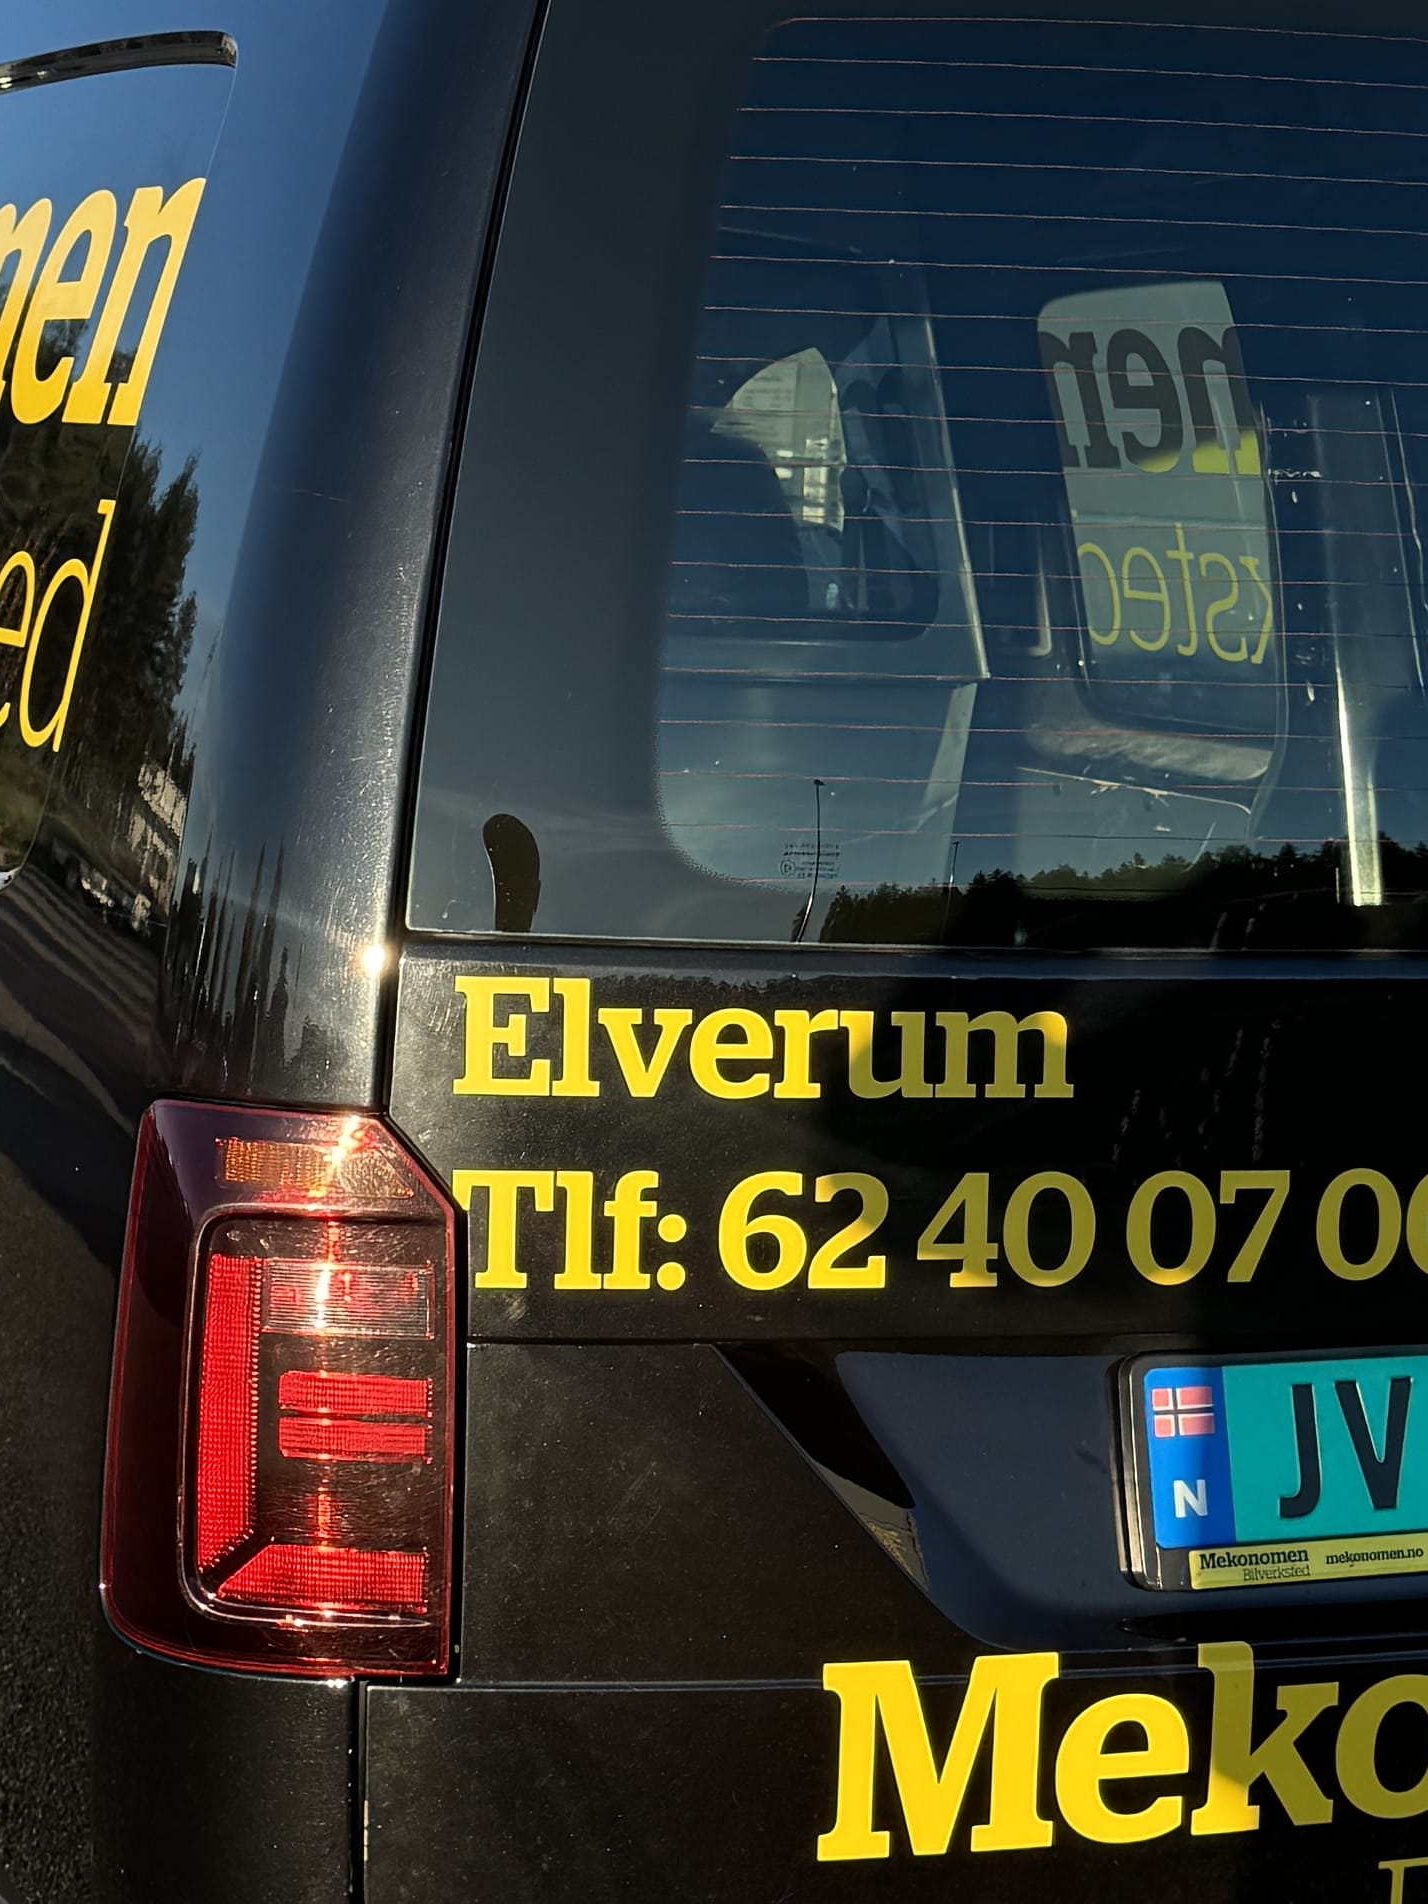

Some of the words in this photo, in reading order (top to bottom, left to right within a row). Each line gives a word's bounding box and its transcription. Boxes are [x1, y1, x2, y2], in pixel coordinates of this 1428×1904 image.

[451, 976, 1075, 1100] Elverum
[449, 1169, 688, 1292] Tlf:
[718, 1169, 888, 1292] 62
[916, 1172, 1096, 1289] 40
[1126, 1170, 1290, 1286] 07
[1278, 1375, 1414, 1520] JV
[1172, 1479, 1209, 1520] N
[1199, 1548, 1310, 1570] Mekonomen
[1242, 1563, 1312, 1582] Bilverksted
[1325, 1546, 1424, 1567] mekonomen.no
